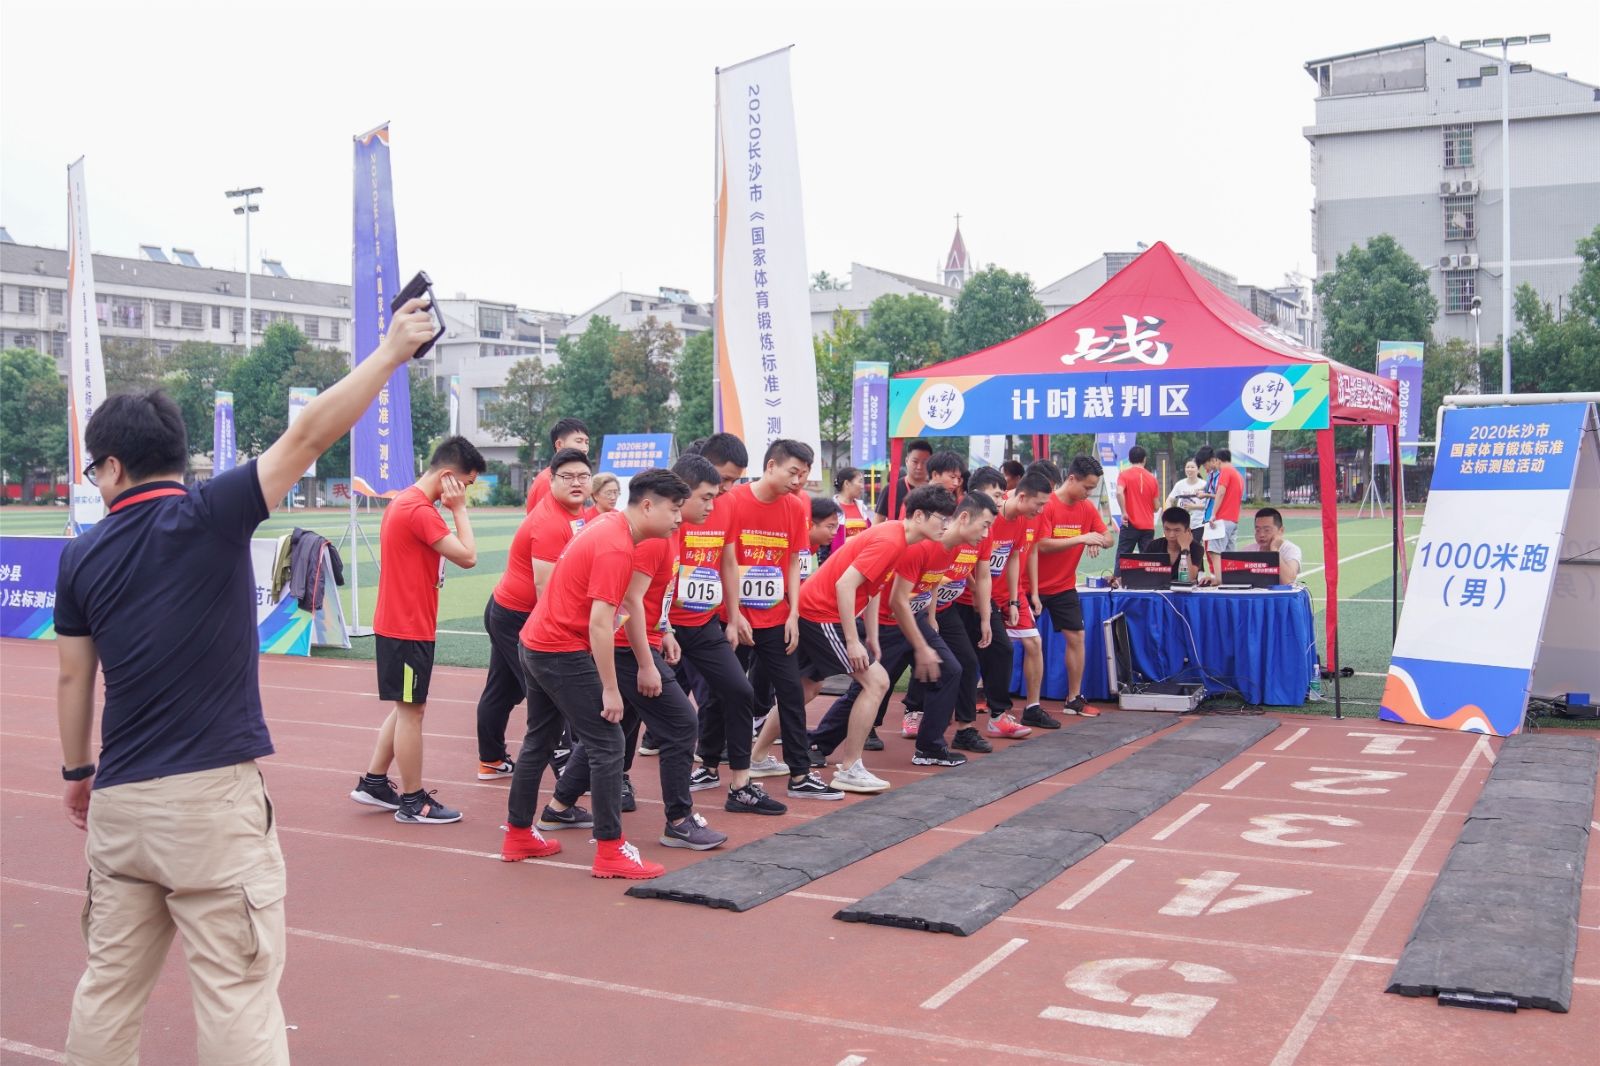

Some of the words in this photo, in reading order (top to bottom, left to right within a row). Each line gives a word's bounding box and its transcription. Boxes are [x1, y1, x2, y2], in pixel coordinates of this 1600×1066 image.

[1011, 384, 1190, 420] 计时裁判区
[1469, 422, 1551, 440] 2020长沙市
[1450, 440, 1564, 458] 国家体育锻炼标准
[1460, 458, 1546, 474] 达标测验活动
[990, 555, 1008, 568] 00
[1421, 541, 1549, 573] 1000米跑
[687, 582, 715, 600] 015
[743, 580, 775, 598] 016
[1347, 732, 1438, 755] 1
[1290, 766, 1407, 795] 2
[1241, 813, 1363, 848] 3
[1157, 870, 1313, 917] 4
[1037, 957, 1237, 1039] 5
